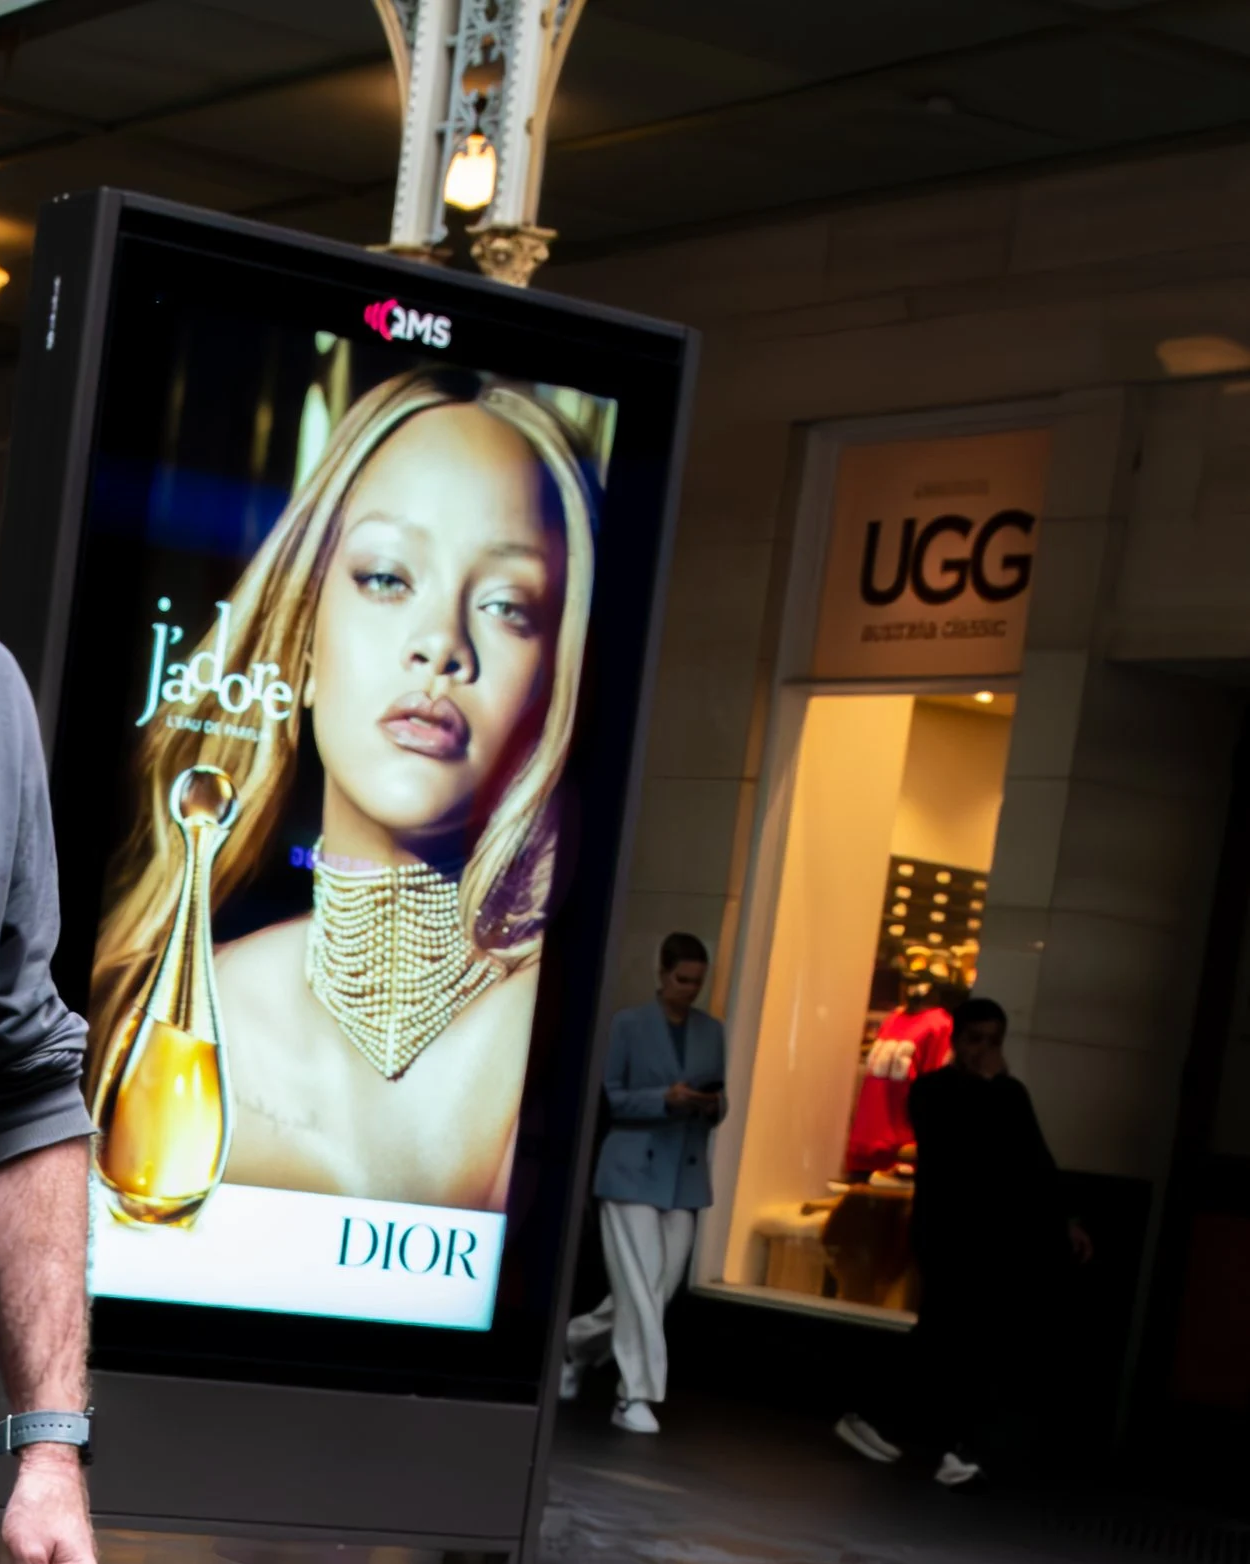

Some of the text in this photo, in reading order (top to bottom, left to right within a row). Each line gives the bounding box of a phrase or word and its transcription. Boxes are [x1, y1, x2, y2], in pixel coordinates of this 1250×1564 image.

[378, 298, 452, 349] QMS
[860, 509, 1036, 606] UGG
[336, 1215, 478, 1280] DIOR
